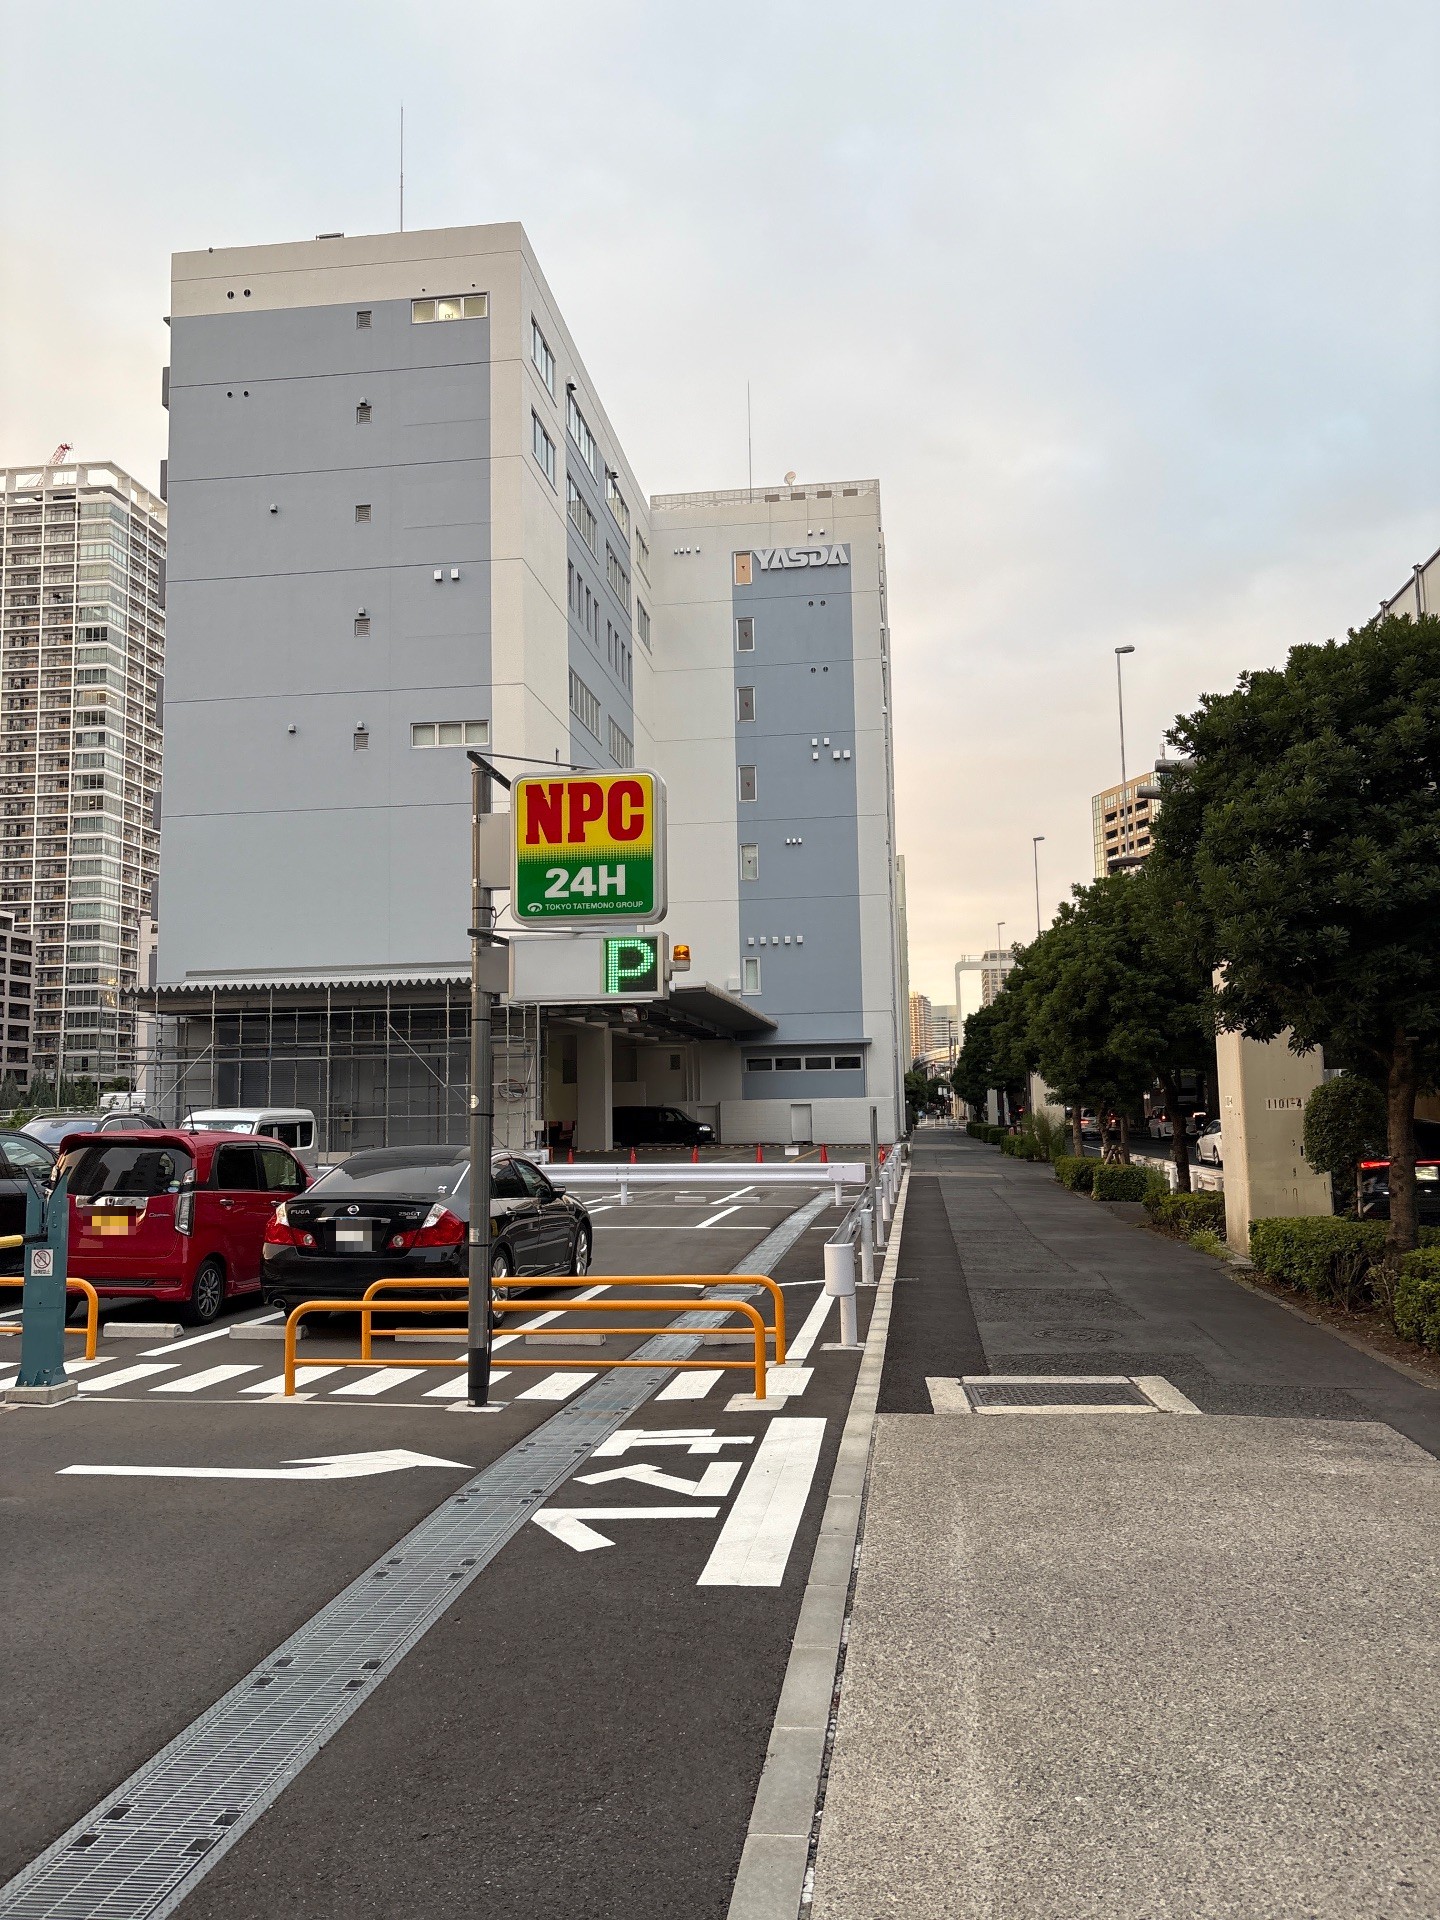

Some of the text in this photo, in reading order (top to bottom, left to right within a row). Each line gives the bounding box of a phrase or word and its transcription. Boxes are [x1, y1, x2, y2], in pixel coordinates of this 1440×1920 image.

[754, 545, 849, 570] YASDA
[525, 780, 645, 845] NPC
[544, 864, 626, 899] 24H
[545, 900, 644, 911] TOKYO TATEMONO GROUP
[608, 939, 654, 994] P
[1268, 1098, 1302, 1109] 1101-4
